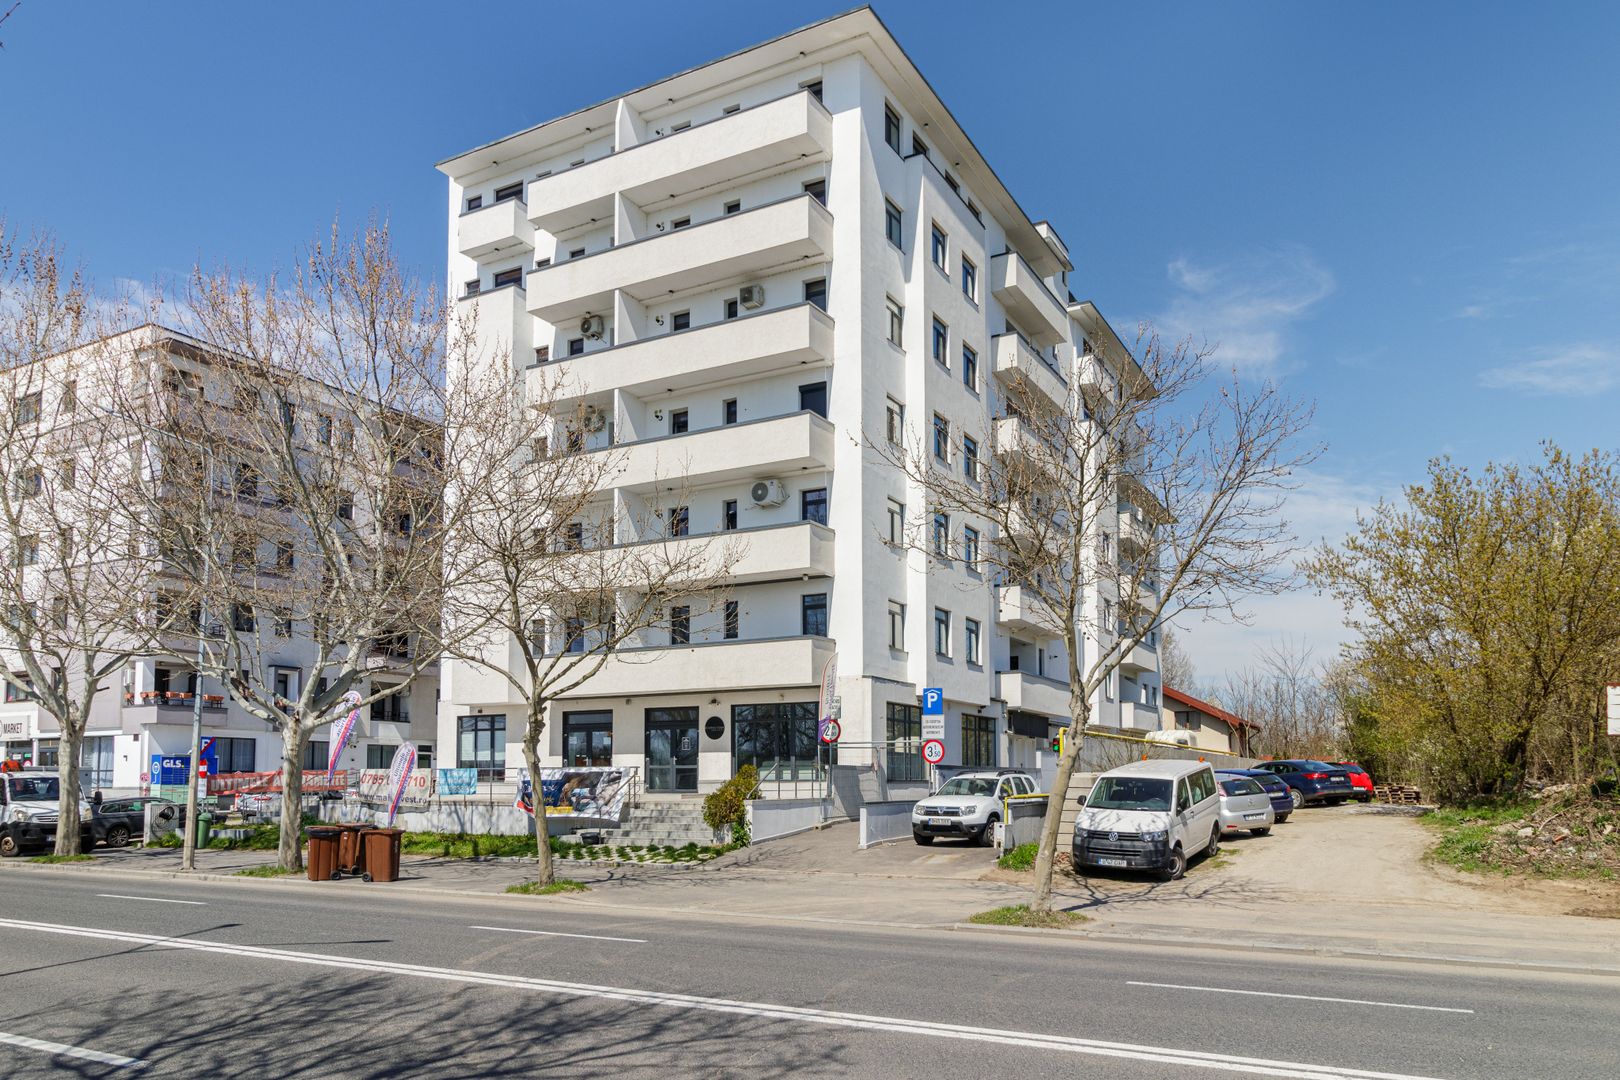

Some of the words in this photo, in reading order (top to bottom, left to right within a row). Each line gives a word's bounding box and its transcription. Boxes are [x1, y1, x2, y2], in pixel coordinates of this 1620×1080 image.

[927, 693, 938, 708] P
[3, 722, 23, 734] MARKET
[927, 746, 933, 757] 3
[360, 773, 384, 785] 0785
